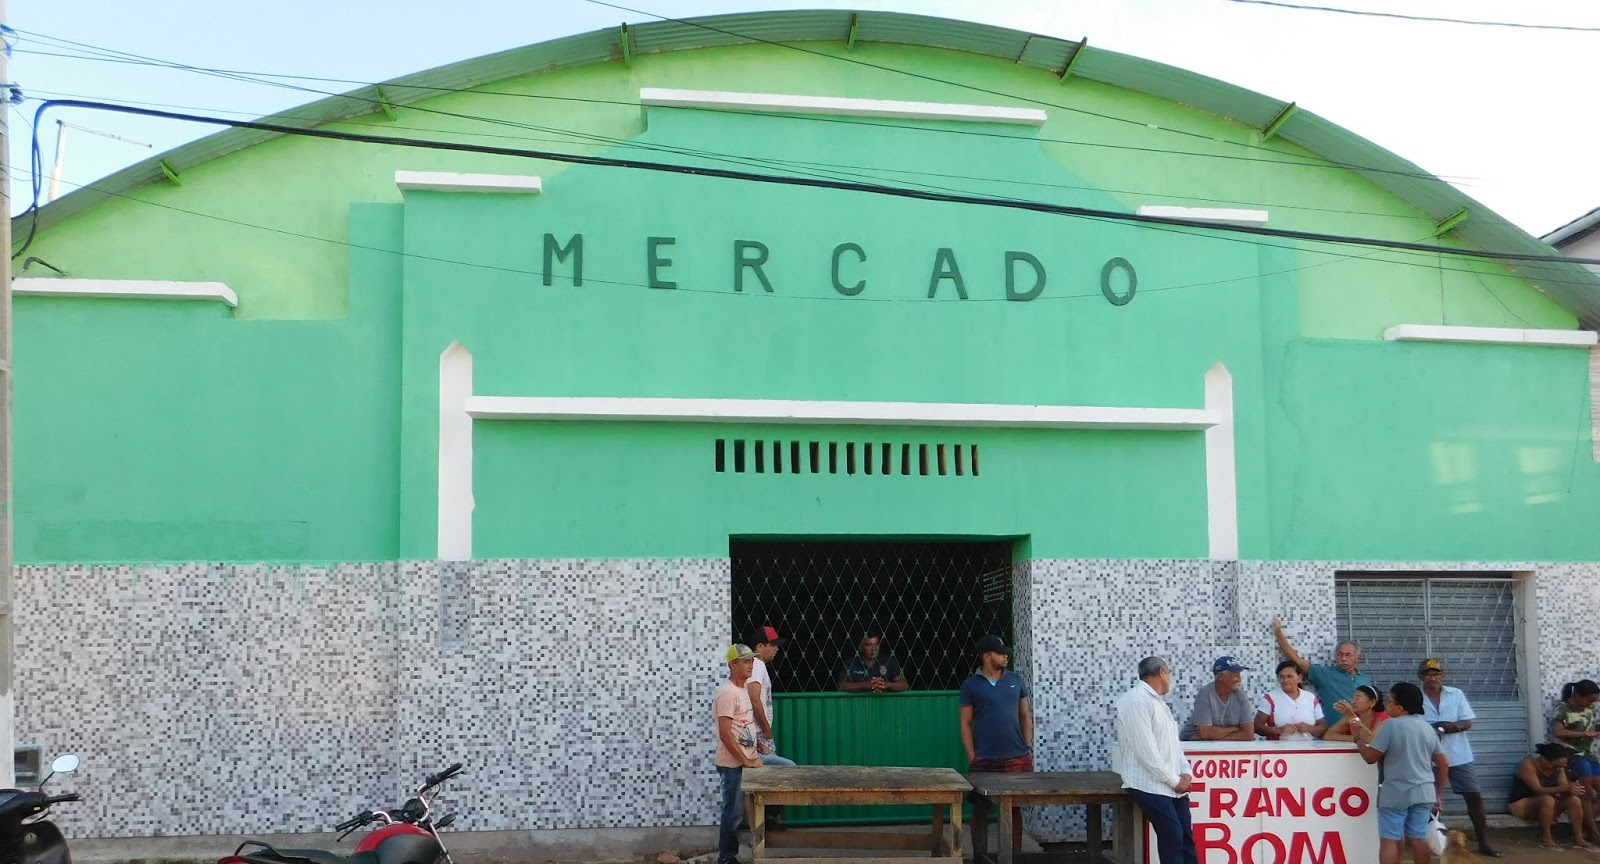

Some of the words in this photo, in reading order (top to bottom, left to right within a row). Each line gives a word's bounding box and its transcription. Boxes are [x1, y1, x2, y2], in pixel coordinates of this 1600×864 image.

[543, 233, 1138, 307] MERCADO
[1188, 758, 1288, 779] GORIFICO
[1192, 822, 1348, 864] BOM
